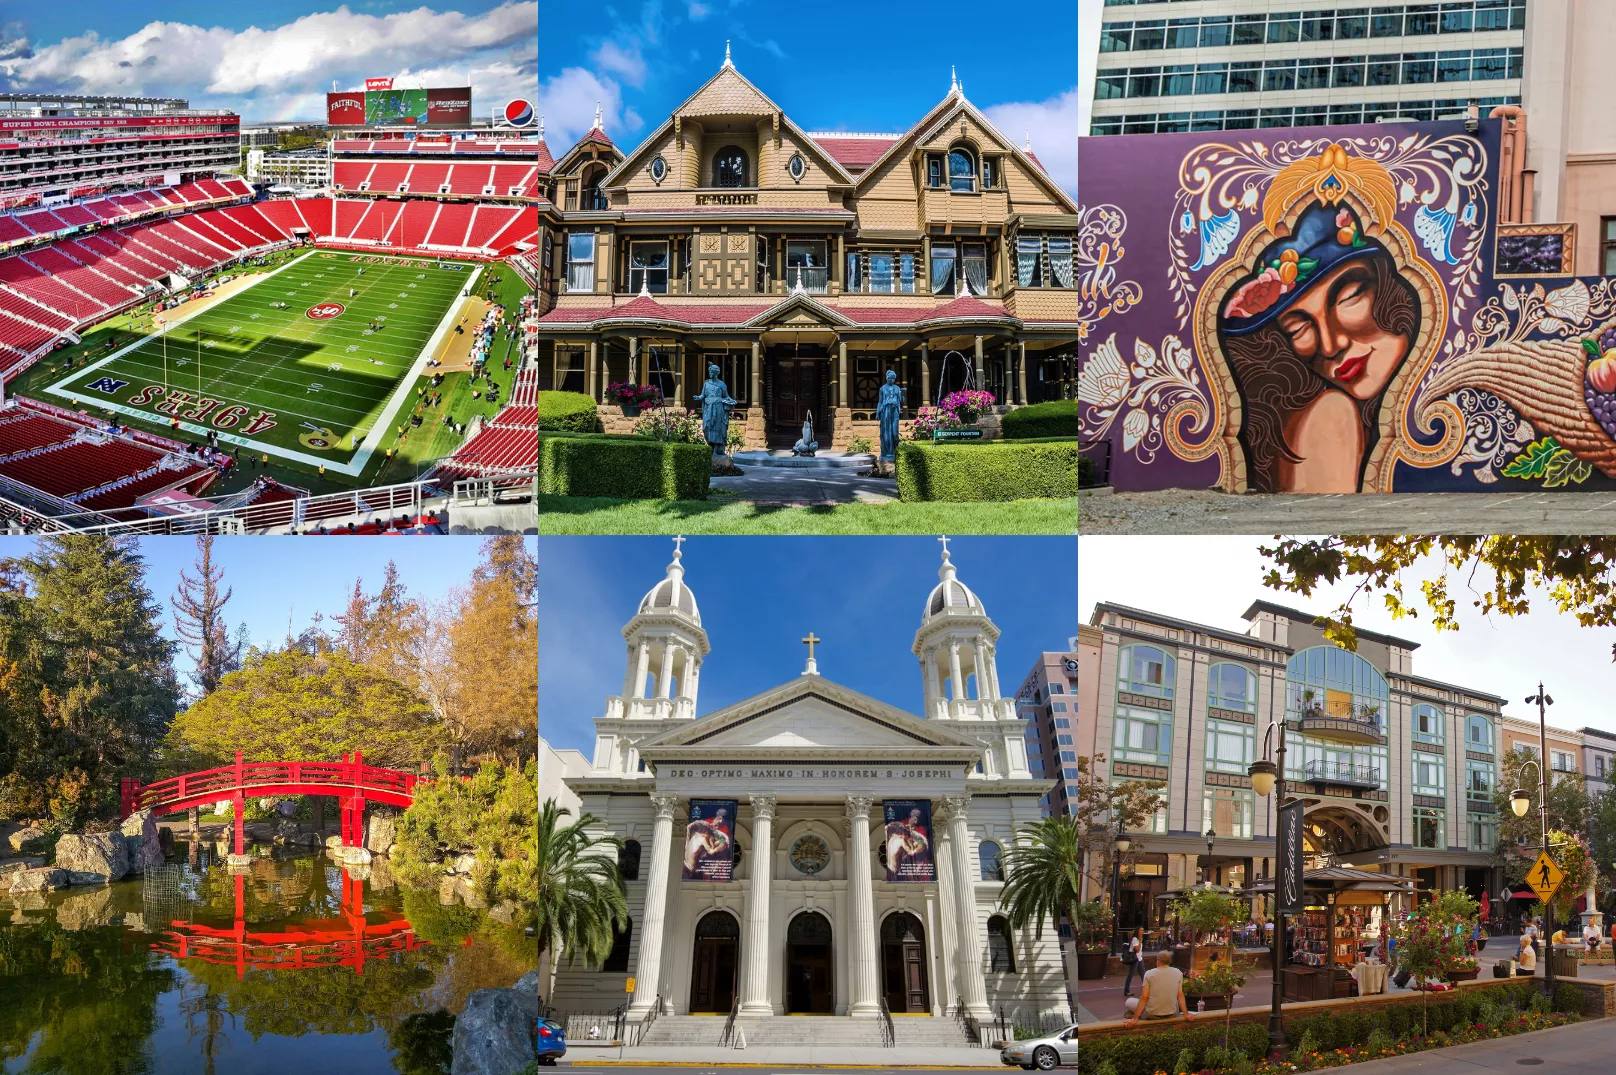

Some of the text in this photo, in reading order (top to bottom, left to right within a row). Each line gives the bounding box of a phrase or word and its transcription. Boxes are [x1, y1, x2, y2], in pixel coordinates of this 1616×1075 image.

[331, 99, 363, 111] FAITHFUL
[128, 385, 278, 436] 49ERS
[184, 424, 226, 438] CUSE
[670, 770, 952, 778] DEO OPTIMO MAXIMO IN HONOREM S JOSEPHI
[1284, 809, 1297, 906] Cadillac
